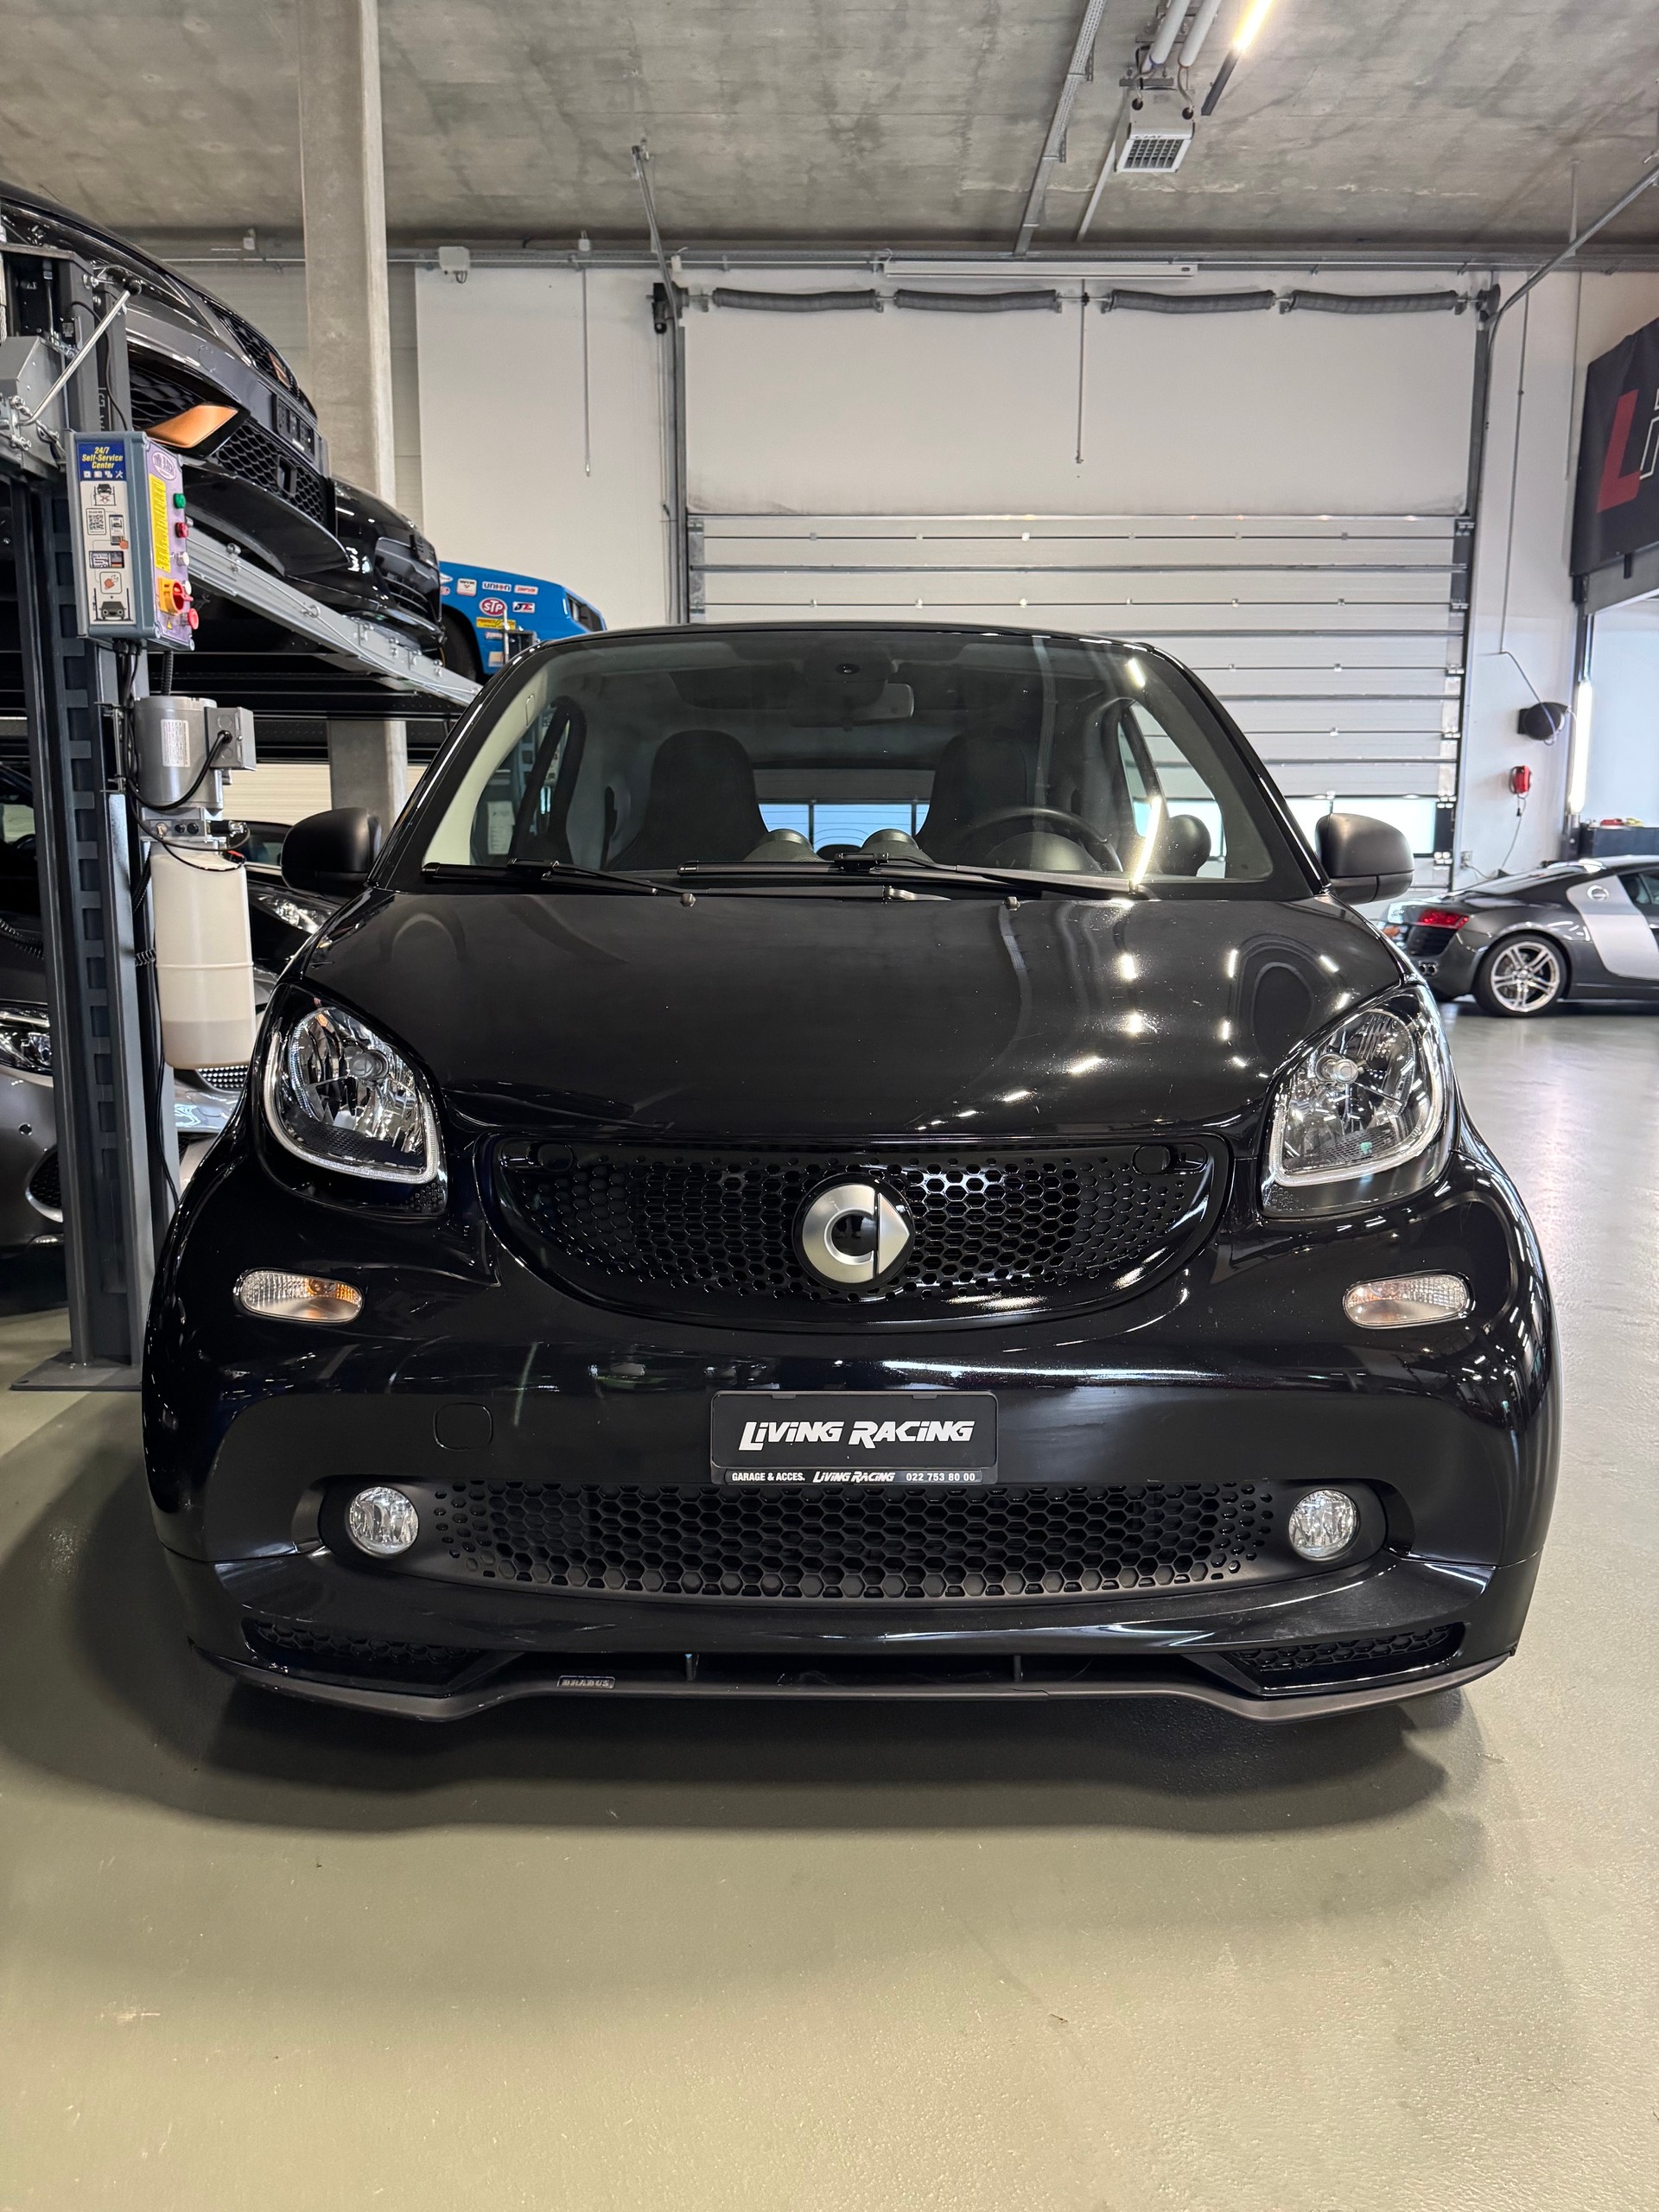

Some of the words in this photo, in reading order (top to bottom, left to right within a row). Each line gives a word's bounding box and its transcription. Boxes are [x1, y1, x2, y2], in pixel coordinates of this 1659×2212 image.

[1596, 388, 1659, 513] L
[81, 454, 124, 462] Self-Service
[484, 600, 503, 613] STP
[732, 1472, 766, 1482] GARAGE
[767, 1472, 775, 1482] &
[776, 1472, 805, 1482] ACCES.
[906, 1472, 925, 1482] 022
[927, 1472, 945, 1482] 753
[948, 1472, 960, 1482] 80
[963, 1472, 976, 1482] 00
